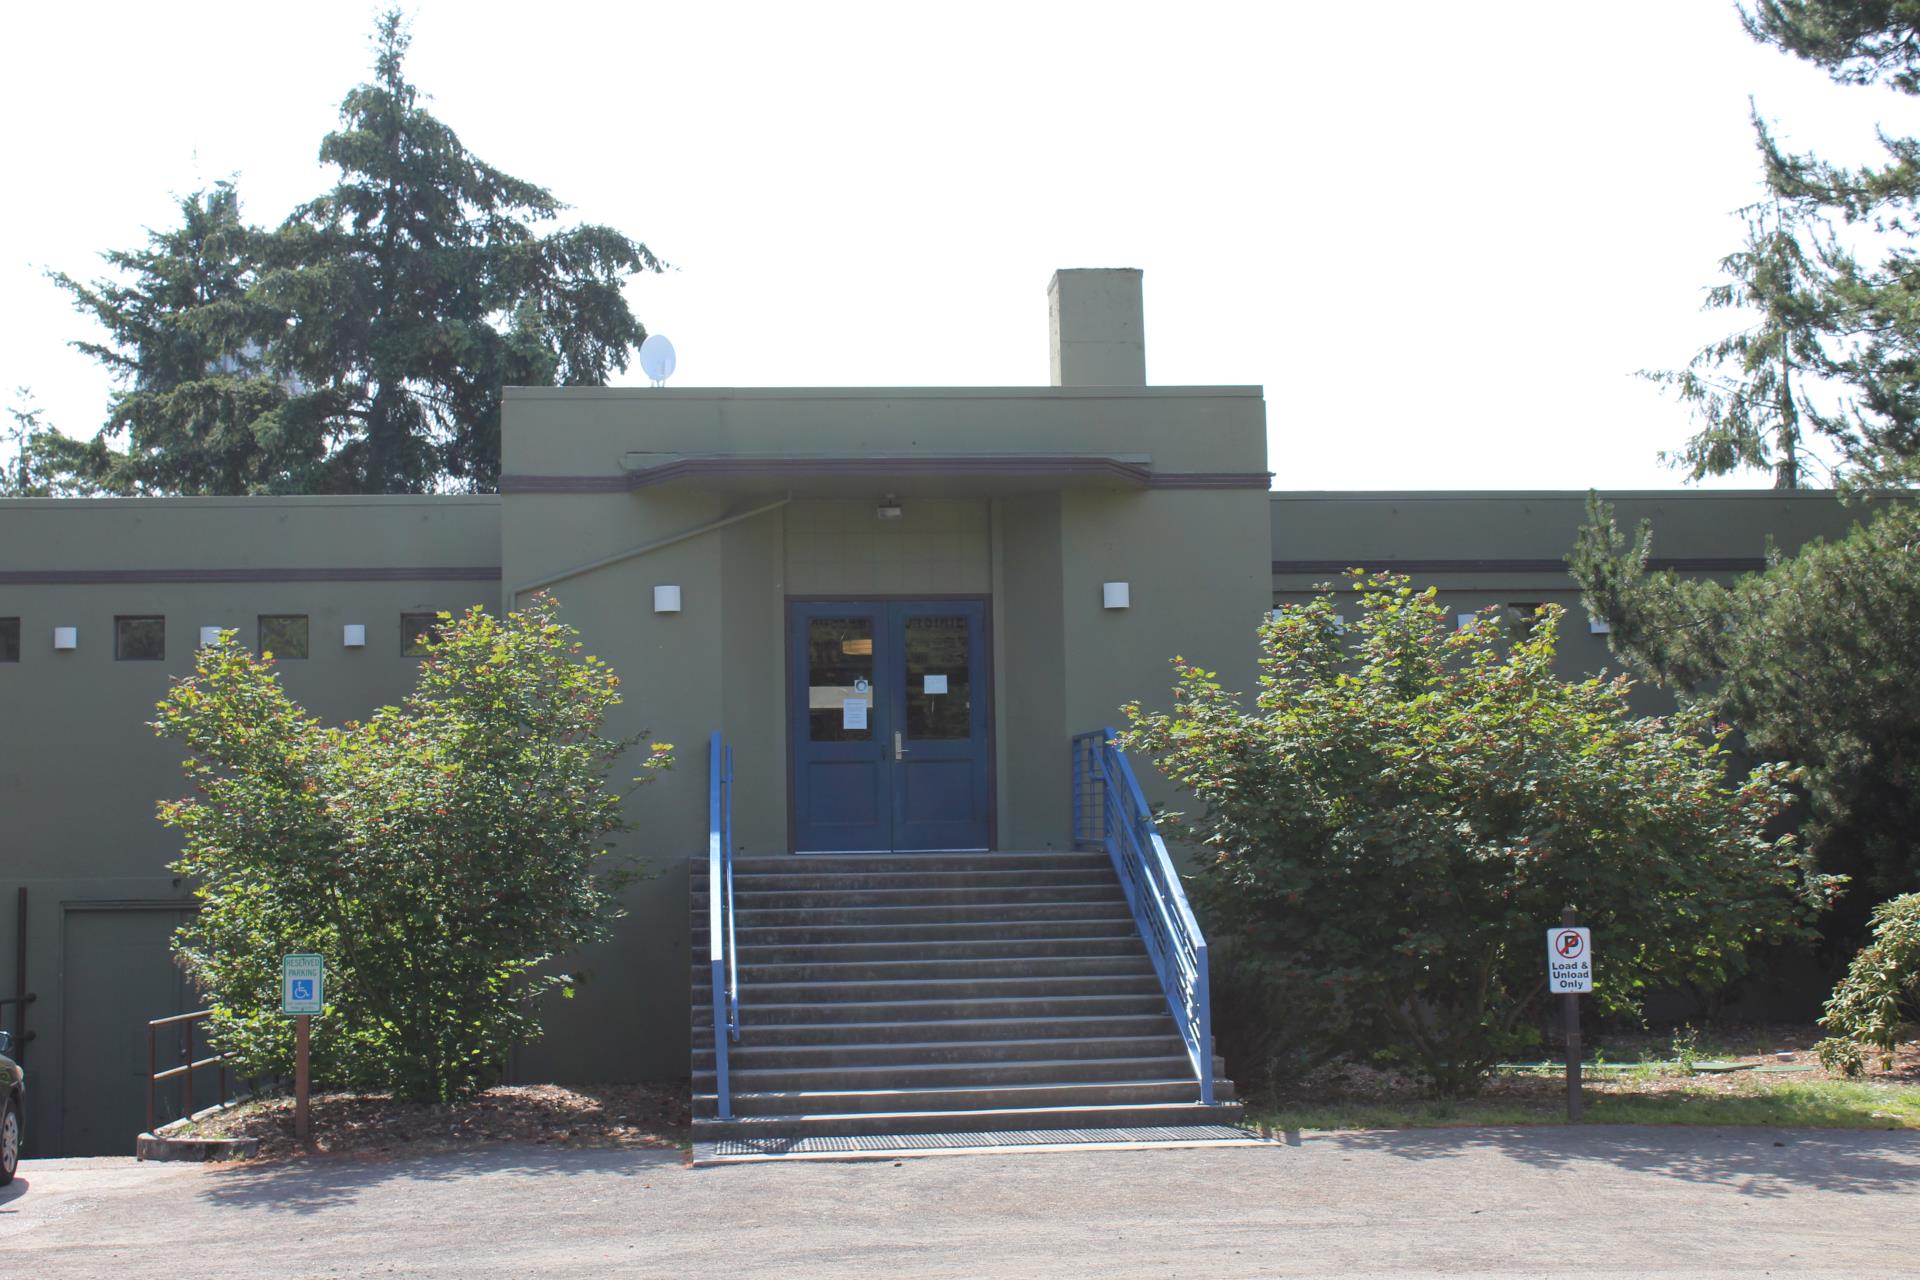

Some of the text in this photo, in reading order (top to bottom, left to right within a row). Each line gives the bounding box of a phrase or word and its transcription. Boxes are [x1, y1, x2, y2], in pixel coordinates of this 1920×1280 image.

[287, 958, 320, 967] RESERVED
[1552, 962, 1588, 970] Load &
[288, 968, 318, 977] PARKING
[1553, 970, 1589, 979] Unload
[1560, 980, 1583, 989] Only
